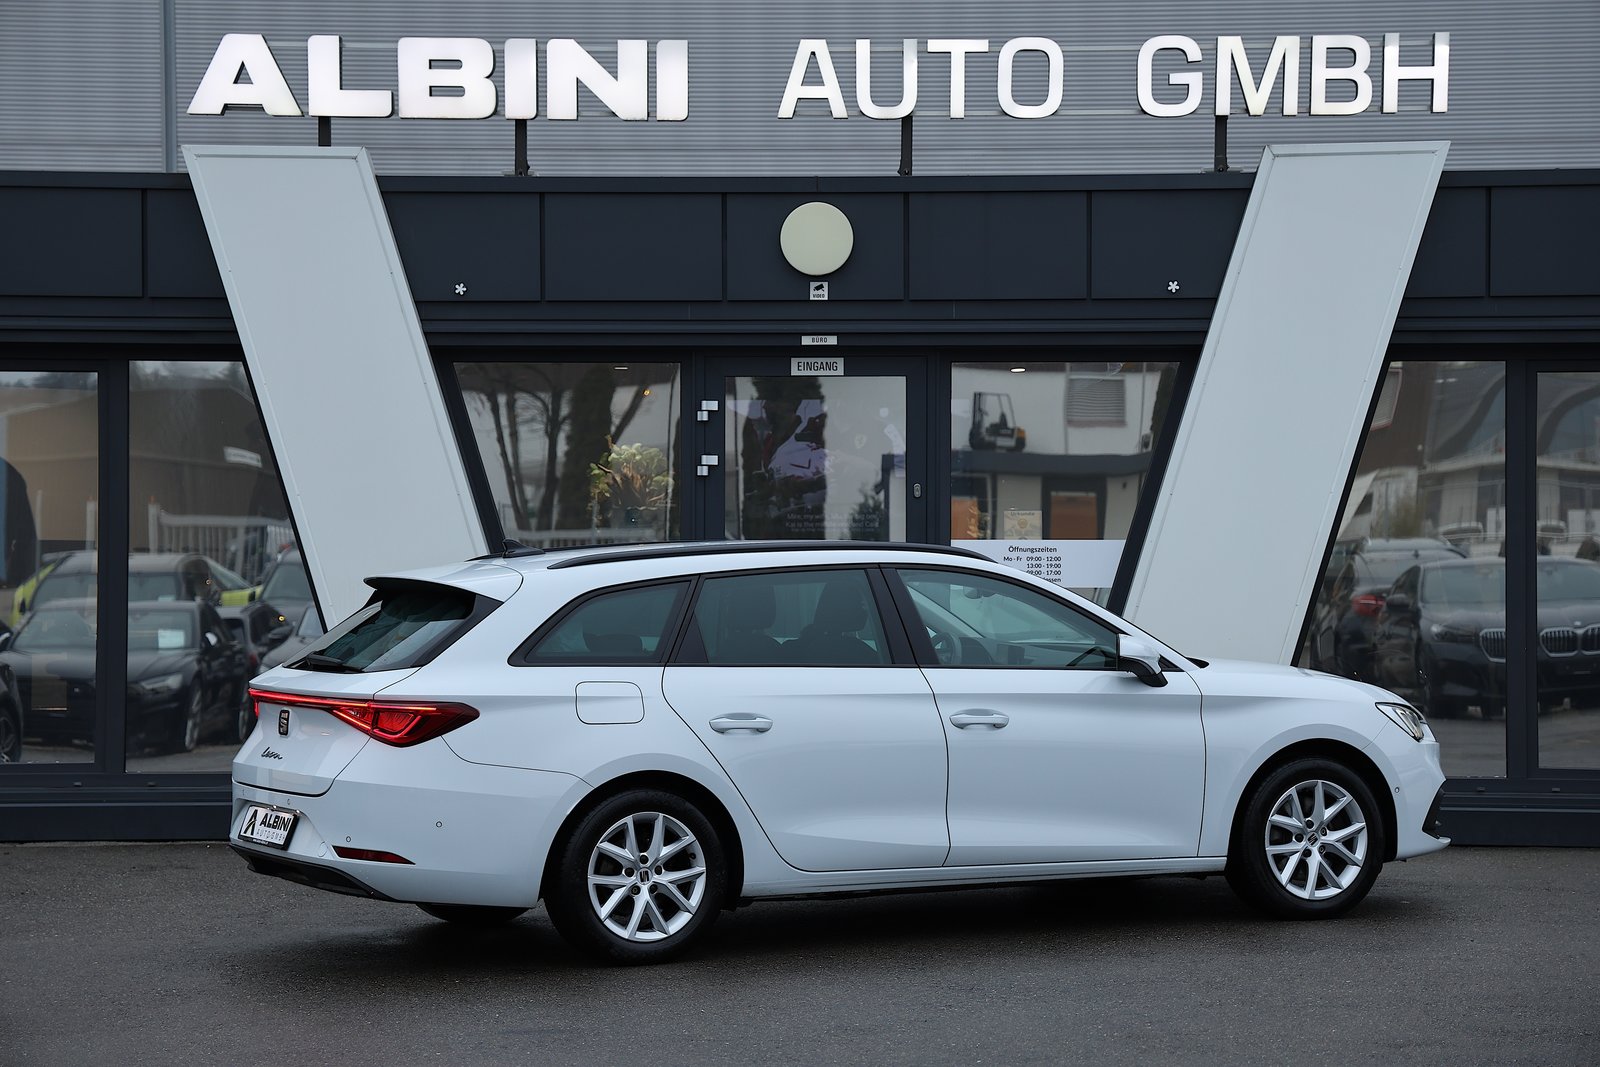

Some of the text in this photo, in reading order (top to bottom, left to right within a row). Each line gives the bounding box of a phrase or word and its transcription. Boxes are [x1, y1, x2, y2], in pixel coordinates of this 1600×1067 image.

[187, 32, 1450, 121] ALBINI AUTO GMBH
[811, 335, 828, 343] BÜRO
[797, 361, 838, 371] EINGANG
[1008, 545, 1057, 554] Öffnungszeiten
[259, 812, 292, 832] ALBINI
